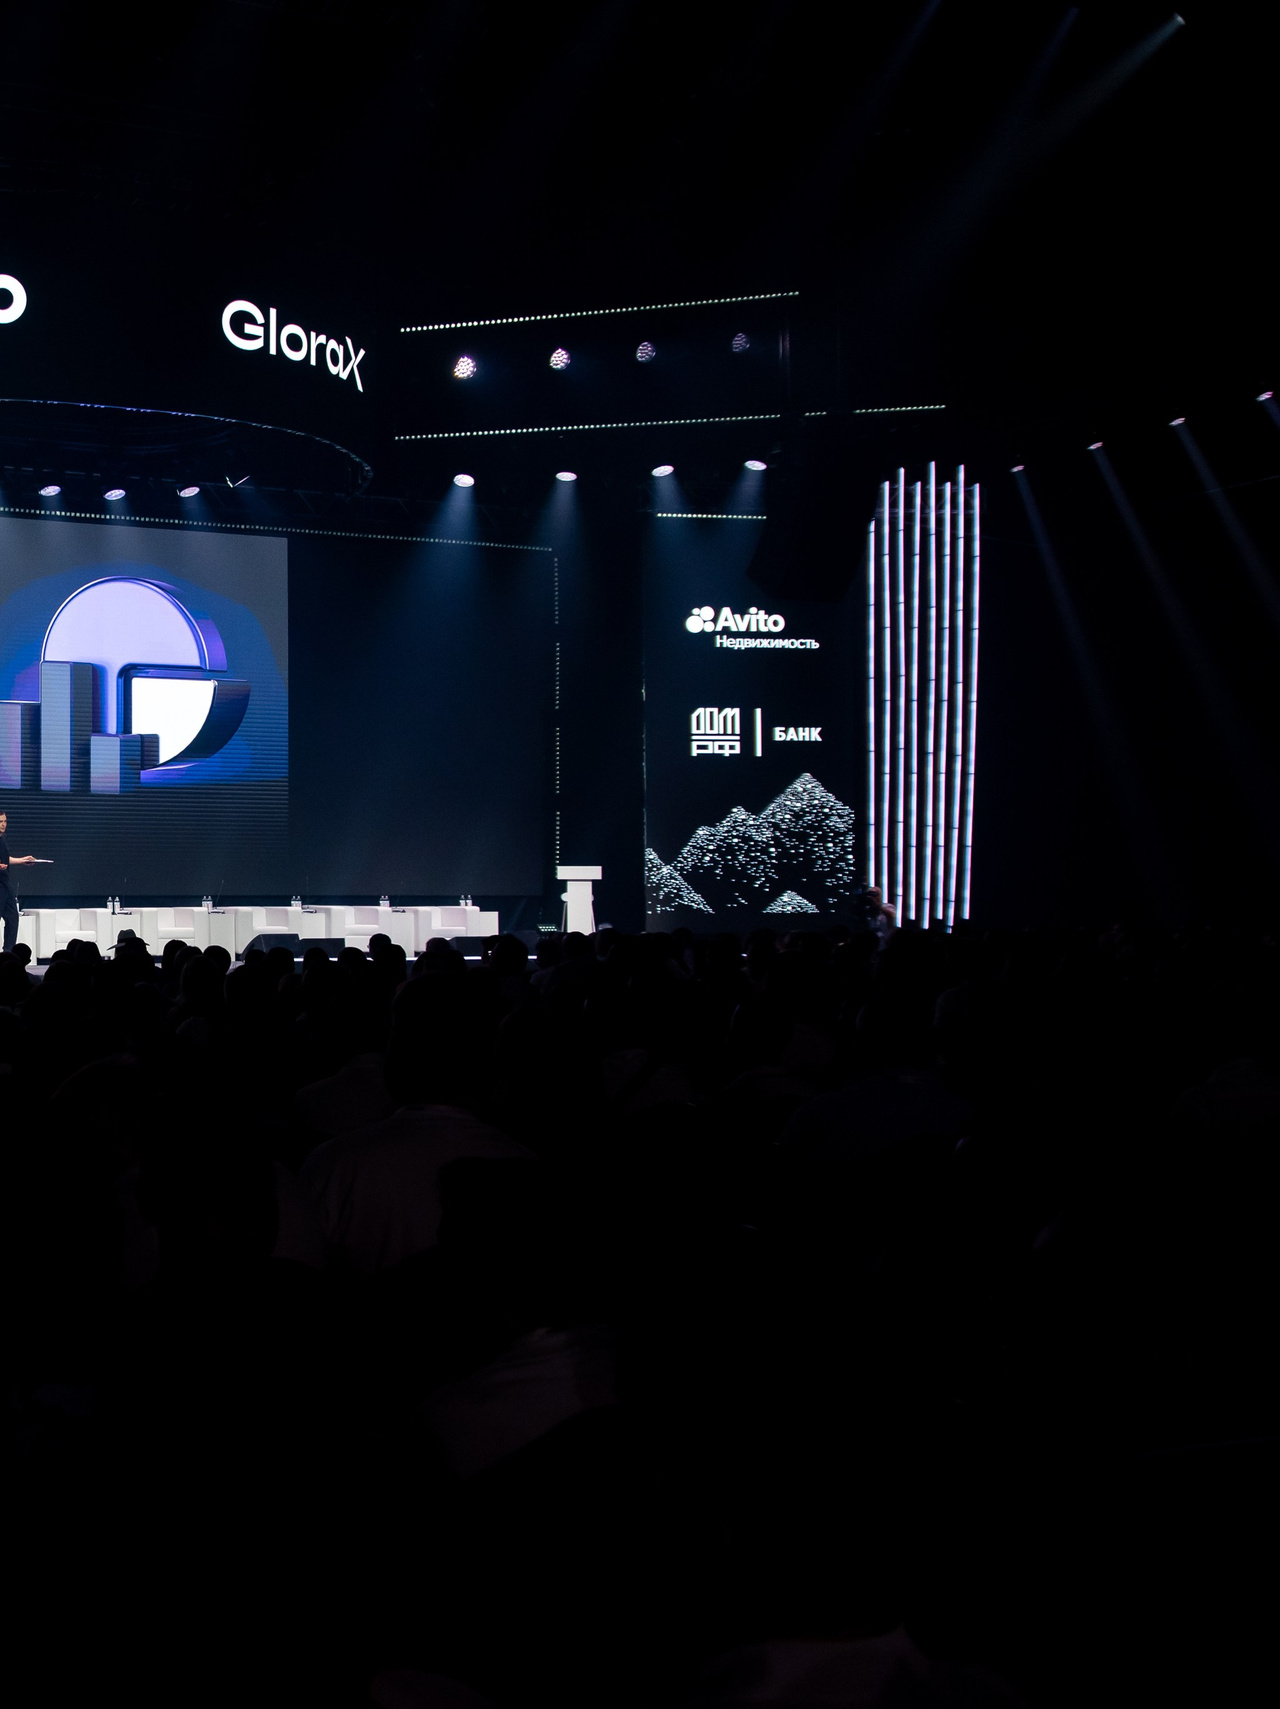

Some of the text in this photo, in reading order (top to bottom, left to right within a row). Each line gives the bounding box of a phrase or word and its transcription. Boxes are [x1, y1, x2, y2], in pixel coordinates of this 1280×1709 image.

[222, 299, 366, 393] GloraX
[715, 606, 786, 633] Avito
[715, 634, 820, 650] Недвижимость
[690, 707, 741, 735] ДОМ
[773, 726, 823, 742] БАНК
